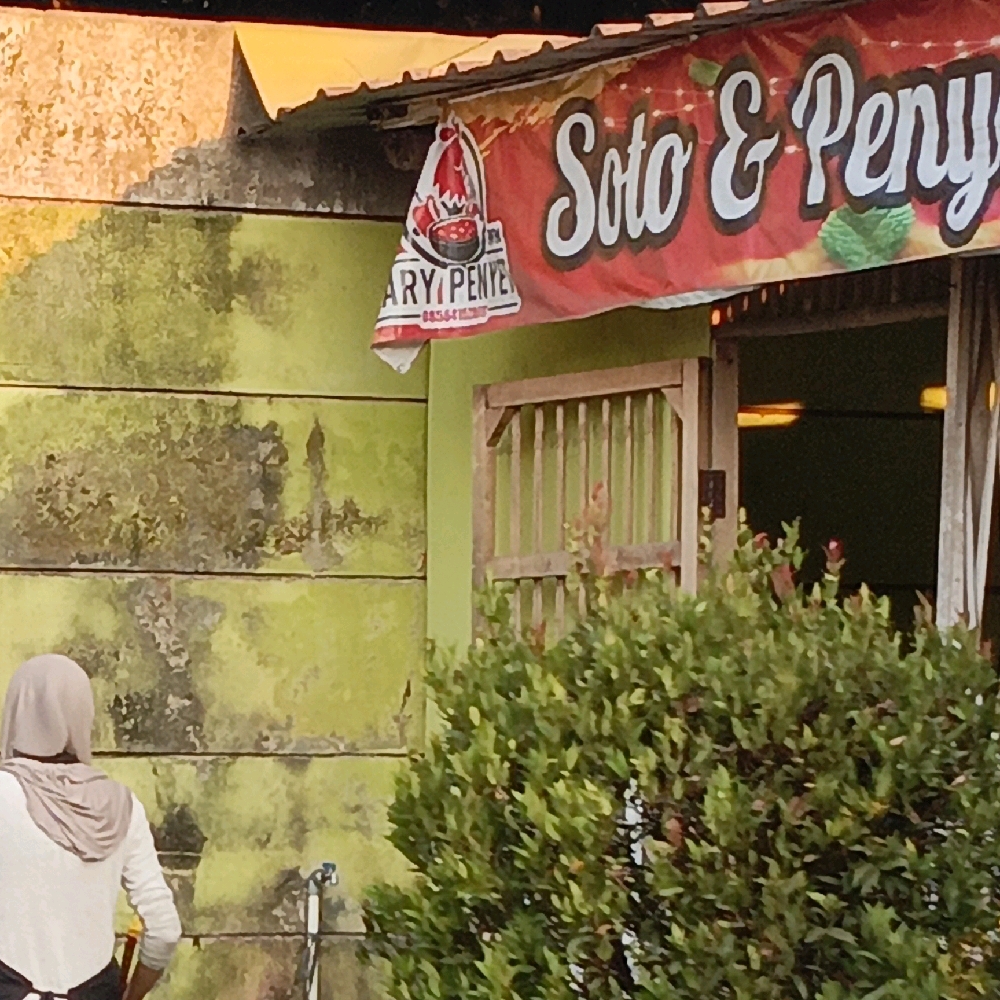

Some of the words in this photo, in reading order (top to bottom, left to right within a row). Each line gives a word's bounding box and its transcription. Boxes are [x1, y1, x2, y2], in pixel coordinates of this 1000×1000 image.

[545, 110, 693, 259] Soto
[709, 69, 780, 221] &
[791, 52, 1000, 232] Peny
